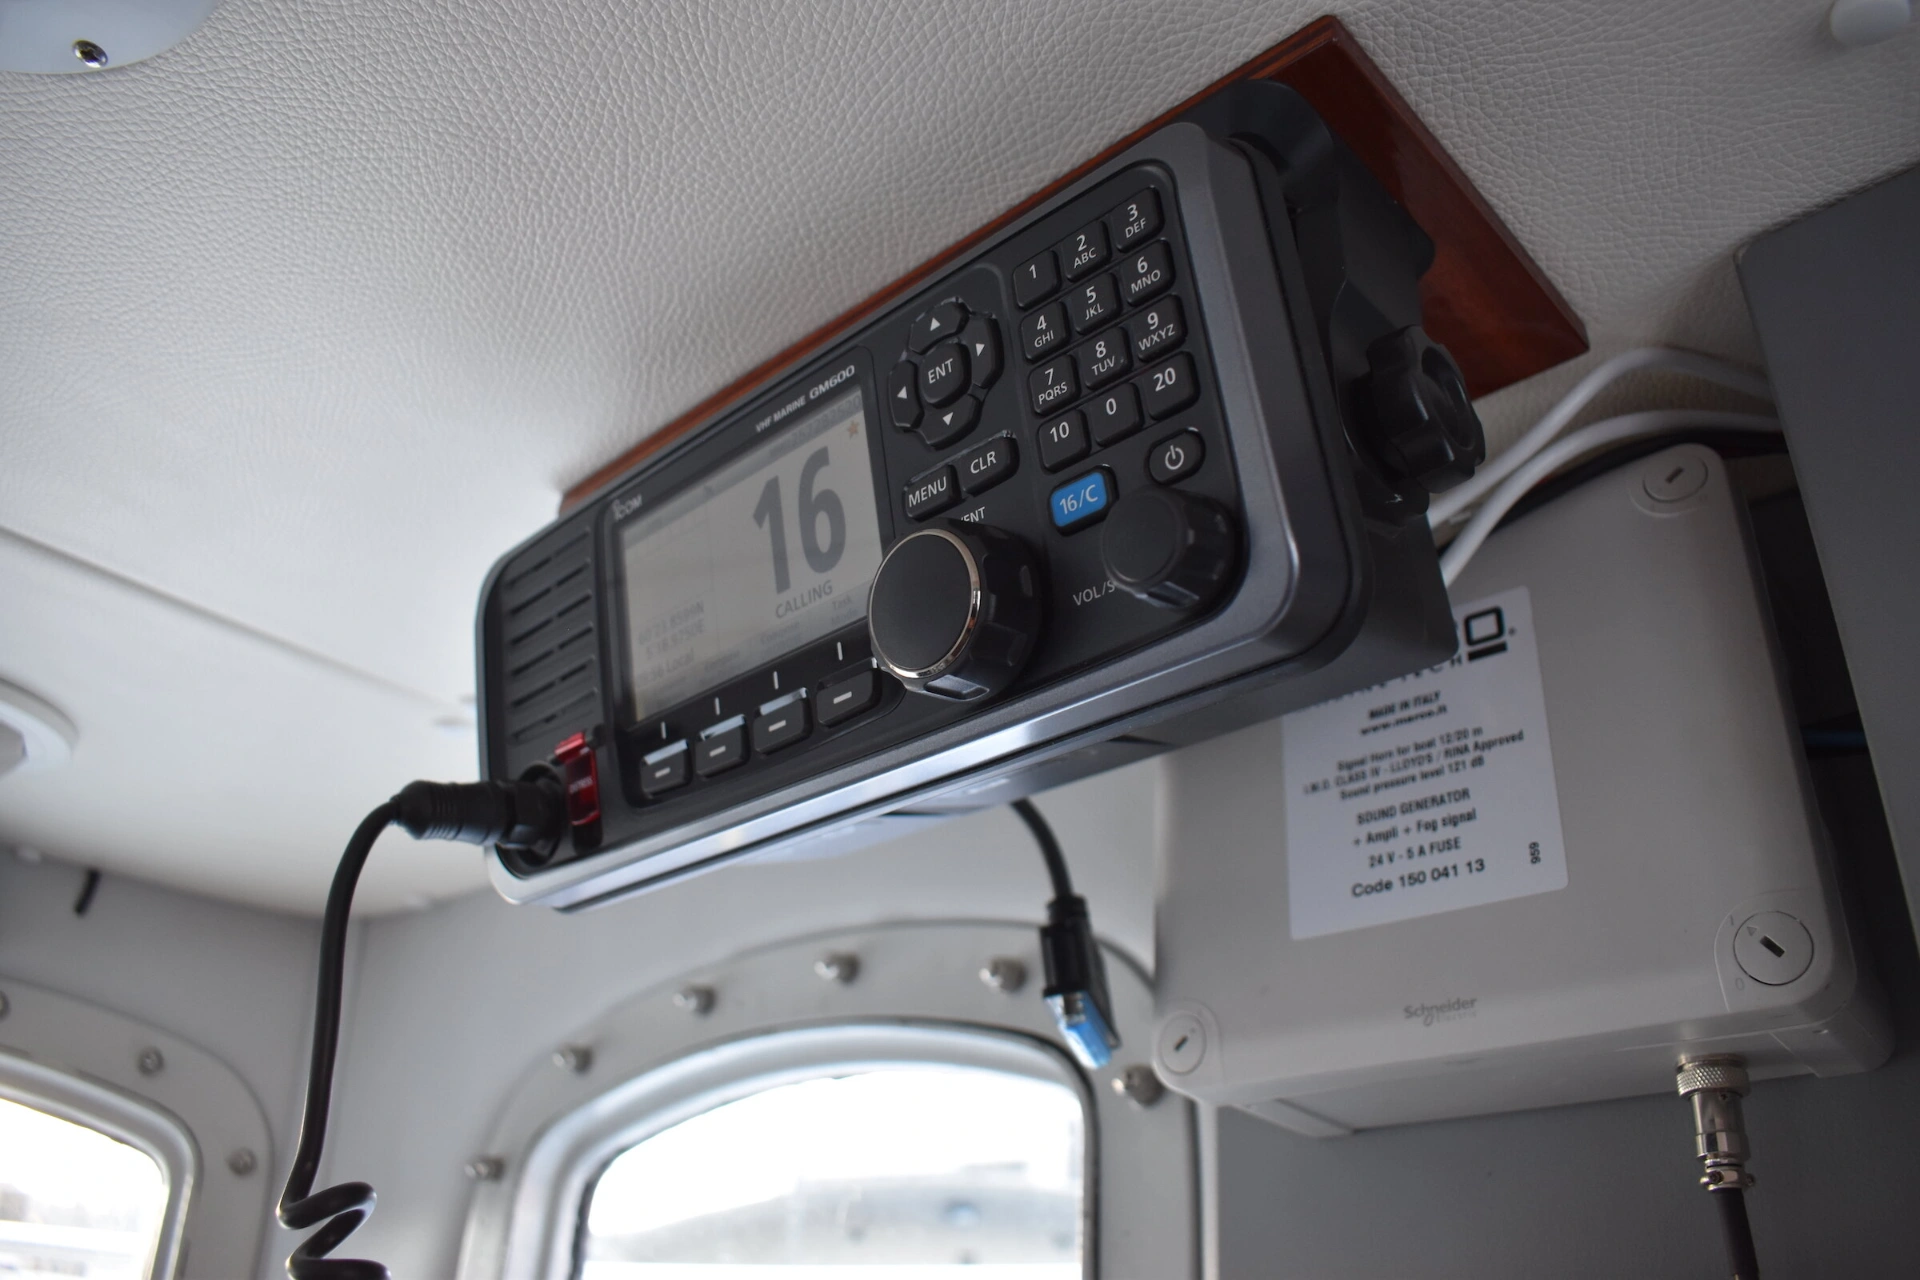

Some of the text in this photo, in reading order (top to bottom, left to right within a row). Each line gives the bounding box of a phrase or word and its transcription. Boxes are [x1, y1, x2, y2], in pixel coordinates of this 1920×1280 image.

[1127, 203, 1139, 222] 3
[1124, 216, 1147, 240] DEF
[1076, 234, 1088, 252] 2
[1073, 246, 1097, 269] ABC
[1136, 256, 1149, 274] 6
[1028, 264, 1037, 280] 1
[1130, 268, 1162, 295] MNO
[1085, 285, 1098, 304] 5
[1035, 314, 1048, 332] 4
[1084, 303, 1105, 321] JKL
[1146, 312, 1159, 331] 9
[1033, 329, 1055, 349] GHI
[1138, 322, 1176, 351] WXYZ
[1095, 340, 1107, 359] 8
[927, 358, 955, 384] ENT
[1043, 367, 1054, 386] 7
[1091, 355, 1116, 377] TUV
[1152, 366, 1177, 392] 20
[755, 364, 856, 434] VHF MARINE GM600
[1038, 380, 1068, 405] PQRS
[1104, 397, 1117, 417] 0
[1049, 421, 1070, 443] 10
[969, 450, 997, 475] CLR
[907, 475, 948, 508] MENU
[1058, 483, 1099, 515] 16/C
[753, 446, 847, 595] 16
[961, 506, 985, 523] ENT
[774, 579, 834, 620] CALLING
[1368, 690, 1441, 720] MADE IN ITALY
[1337, 756, 1368, 772] Signal
[1370, 750, 1394, 763] Horn
[1396, 744, 1413, 758] for
[1413, 738, 1437, 753] boat
[1471, 726, 1484, 737] m
[1443, 743, 1470, 760] RINA
[1472, 729, 1524, 753] Approved
[1340, 755, 1486, 800] Sound pressure level 121 dB
[1356, 787, 1471, 826] SOUND GENERATOR
[1366, 826, 1400, 846] Ampli
[1416, 817, 1438, 834] Fog
[1442, 807, 1478, 828] signal
[1368, 854, 1385, 870] 24
[1386, 851, 1396, 864] V
[1407, 847, 1416, 861] 5
[1417, 843, 1428, 857] A
[1429, 836, 1463, 854] FUSE
[1351, 857, 1486, 899] Code 150 041 13
[1402, 996, 1478, 1027] Schneider
